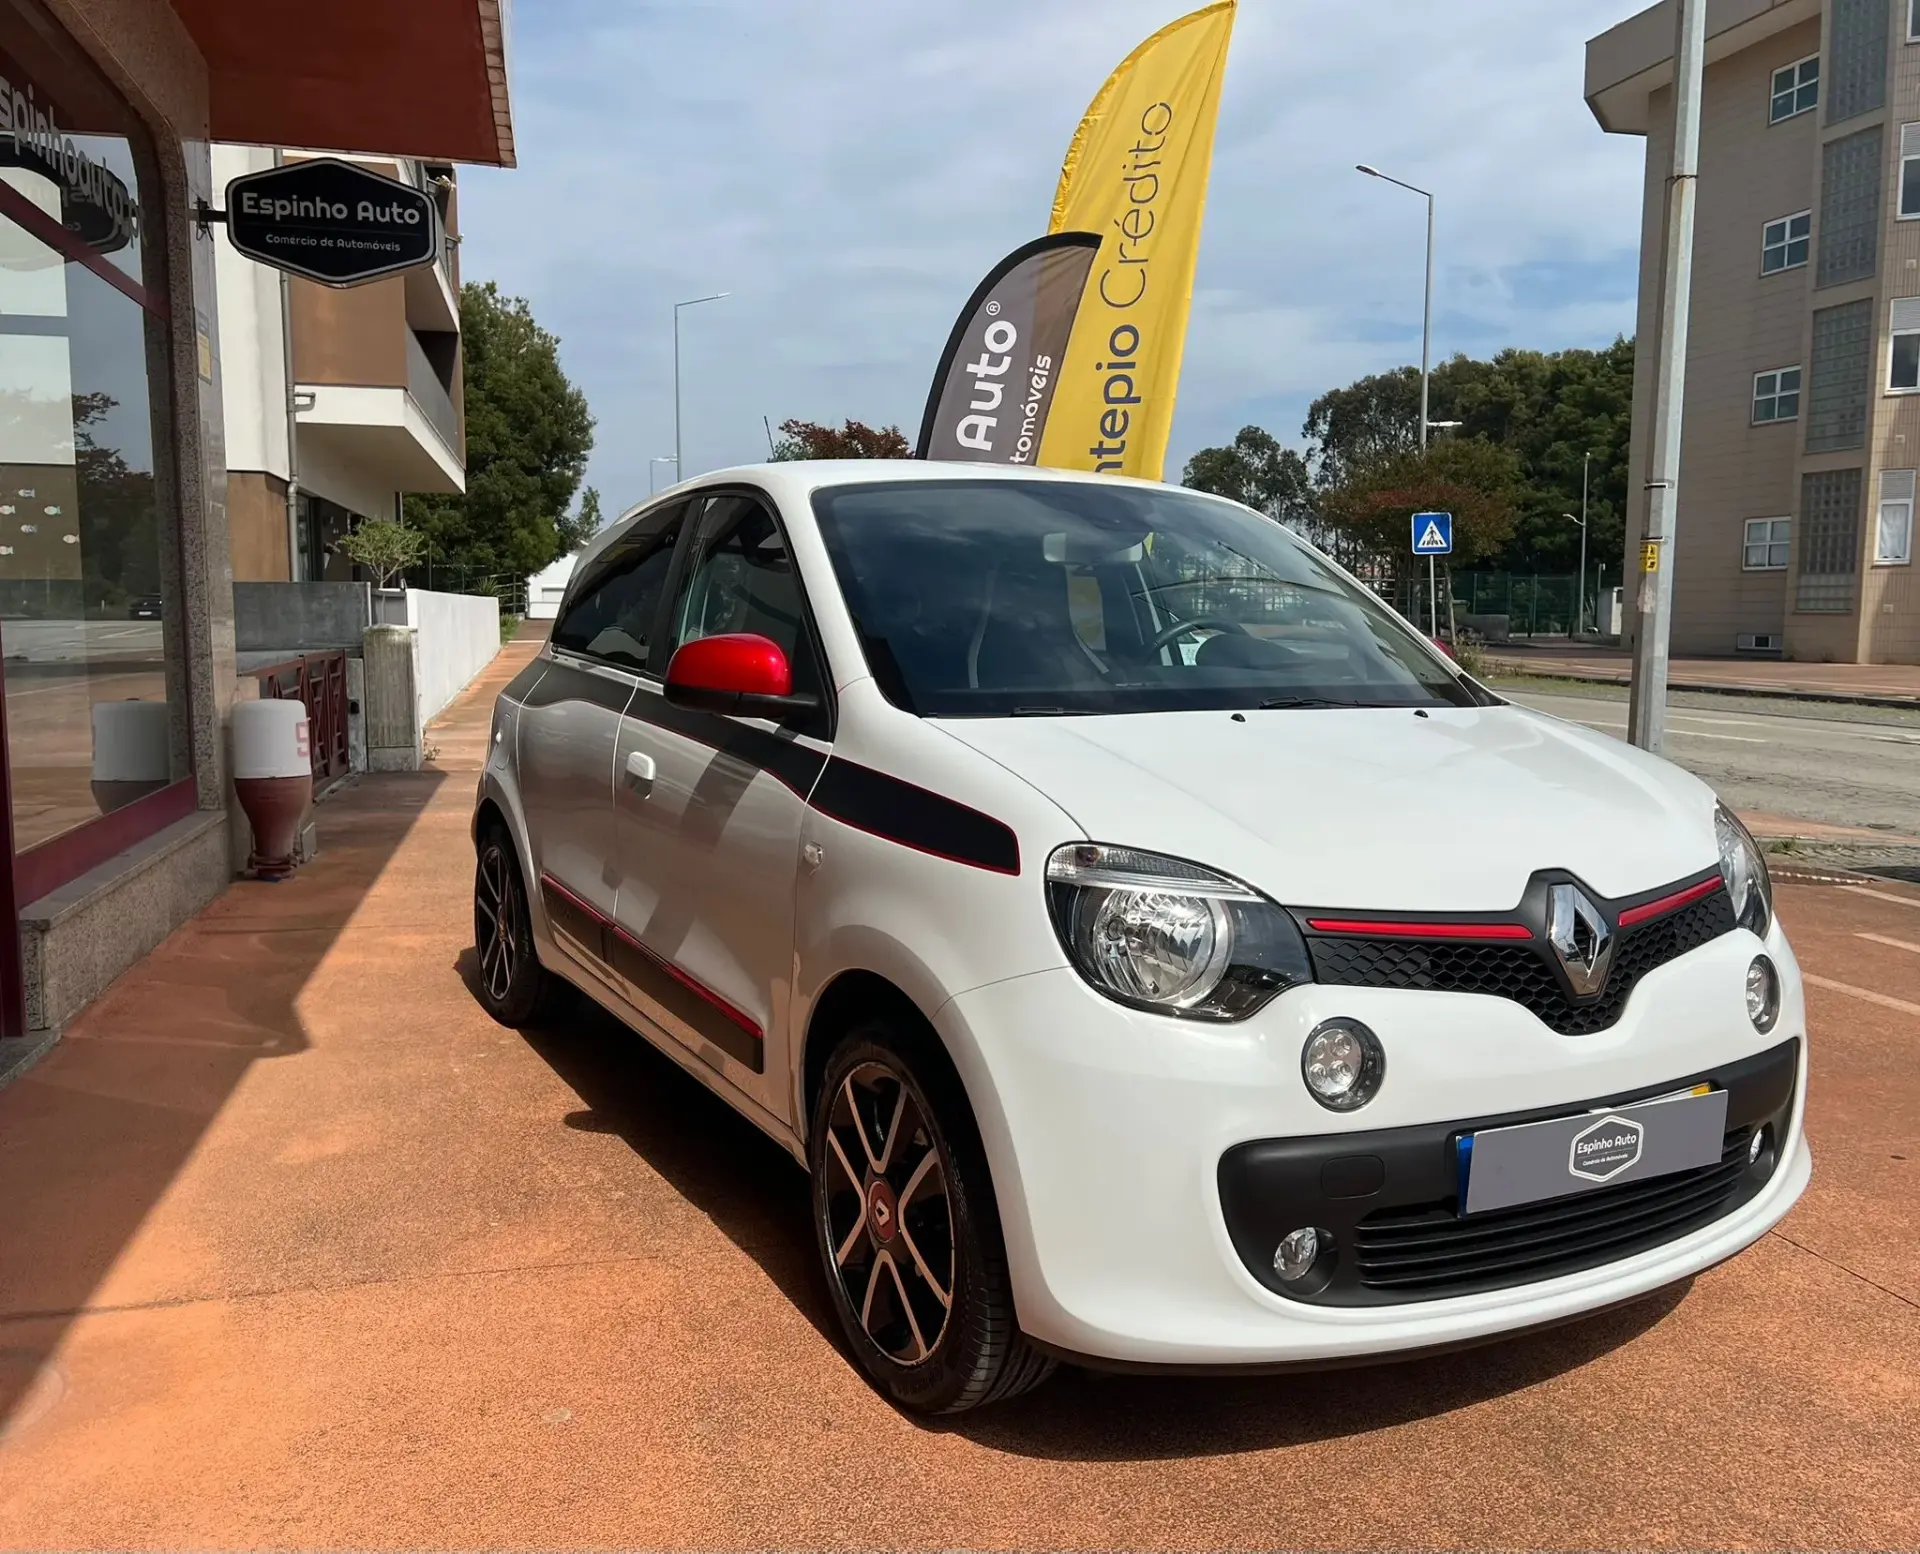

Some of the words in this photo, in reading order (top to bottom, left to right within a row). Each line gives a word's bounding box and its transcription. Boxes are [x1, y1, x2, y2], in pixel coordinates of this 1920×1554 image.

[242, 192, 348, 221] Espinho
[357, 200, 420, 225] Auto
[1100, 102, 1172, 308] Crédito
[320, 236, 334, 247] de
[337, 238, 401, 252] Automóveis
[1009, 354, 1052, 464] tomóveis
[1576, 1138, 1613, 1155] Espinho
[1614, 1133, 1637, 1147] Auto
